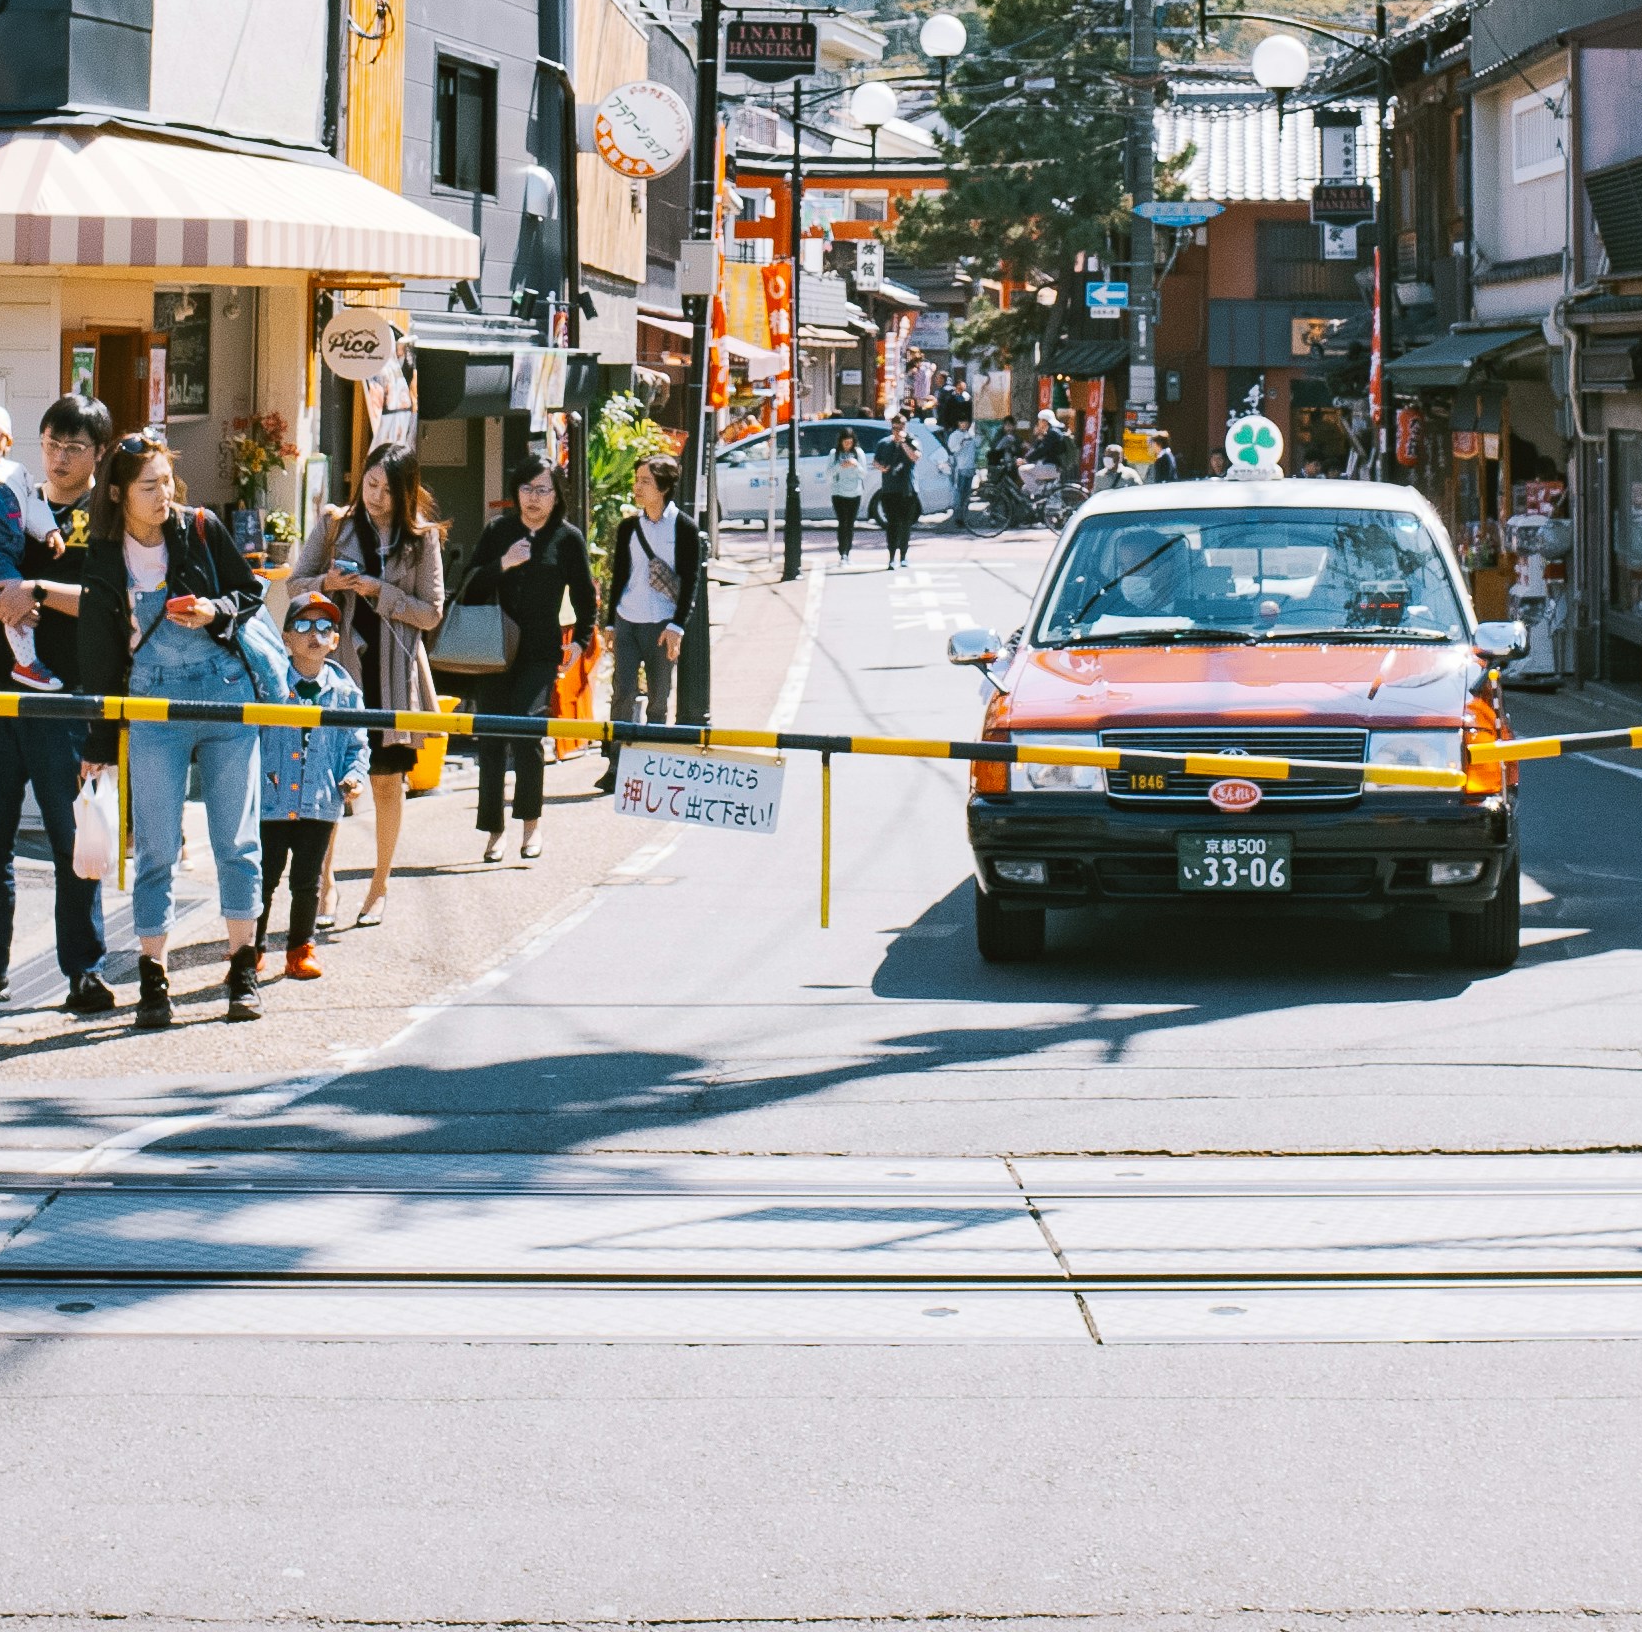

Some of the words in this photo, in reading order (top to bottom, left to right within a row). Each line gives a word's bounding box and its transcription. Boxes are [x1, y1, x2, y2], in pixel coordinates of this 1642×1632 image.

[740, 26, 803, 41] INARI
[728, 41, 813, 57] HANEIKAI
[608, 96, 673, 160] フラワーショップ
[328, 331, 380, 353] Pico
[643, 754, 759, 791] とじこめられたら
[1130, 774, 1165, 790] 1846
[1183, 866, 1201, 880] い
[1203, 857, 1286, 887] 33-06
